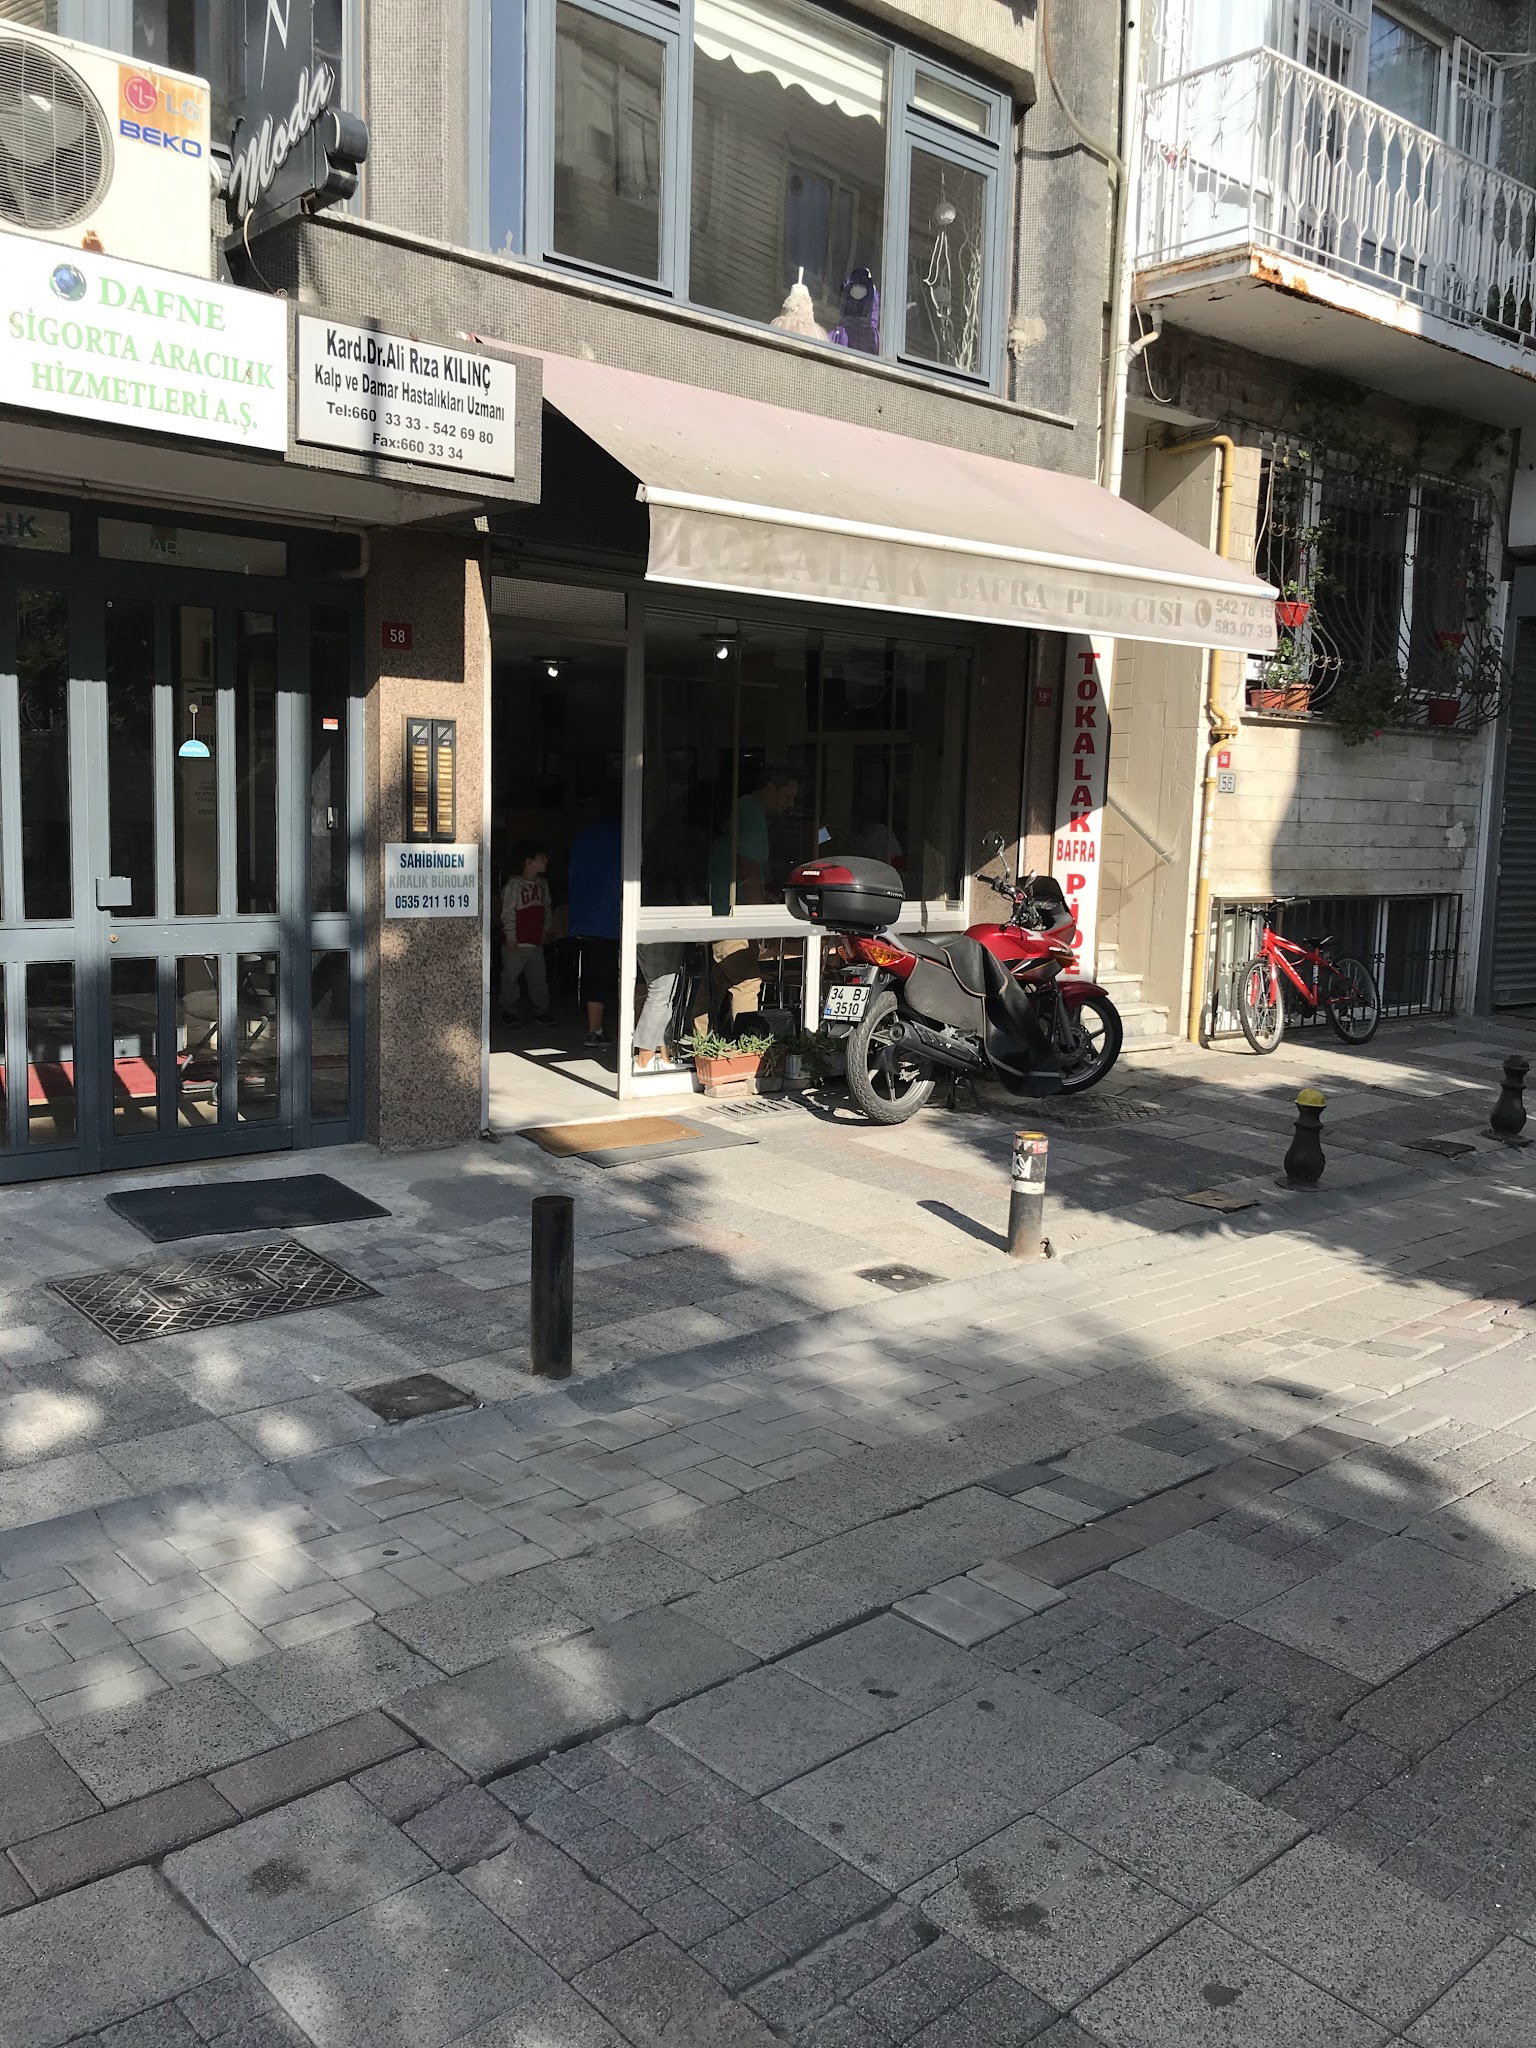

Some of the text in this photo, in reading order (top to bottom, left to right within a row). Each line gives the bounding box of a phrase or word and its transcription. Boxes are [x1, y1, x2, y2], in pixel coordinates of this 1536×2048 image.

[166, 94, 199, 121] LG
[119, 119, 202, 158] BEKO
[229, 62, 336, 221] Moda
[98, 276, 226, 332] DAFNE
[9, 307, 275, 390] SİGORTA ARACILIK
[326, 328, 491, 396] Kard.Dr.Ali Rıza KILINÇ
[31, 360, 258, 435] HİZMETLERİ A.Ş.
[314, 363, 505, 421] Kalp ve Damar Hastalıkları Uzmanı
[326, 401, 377, 422] Tel:660
[385, 412, 401, 426] 33
[405, 416, 421, 430] 33
[433, 422, 456, 437] 542
[460, 427, 475, 441] 69
[479, 431, 494, 444] 80
[372, 432, 463, 460] Fax:660 33 34
[954, 572, 1050, 610] BAFRA
[1216, 598, 1239, 614] 542
[1241, 601, 1256, 617] 78
[1259, 604, 1273, 619] 15
[390, 628, 405, 643] 58
[1214, 619, 1273, 638] 583 07 39
[1068, 653, 1100, 833] TOKALAK
[1220, 754, 1229, 764] 56
[1221, 776, 1233, 790] 56
[400, 850, 464, 868] SAHİBİNDEN
[1056, 839, 1095, 862] BAFRA
[389, 871, 475, 888] KİRALIK BÜROLAR
[395, 894, 469, 909] 0535 211 16 19
[831, 988, 869, 1002] 34 BJ
[834, 1002, 860, 1015] 3510
